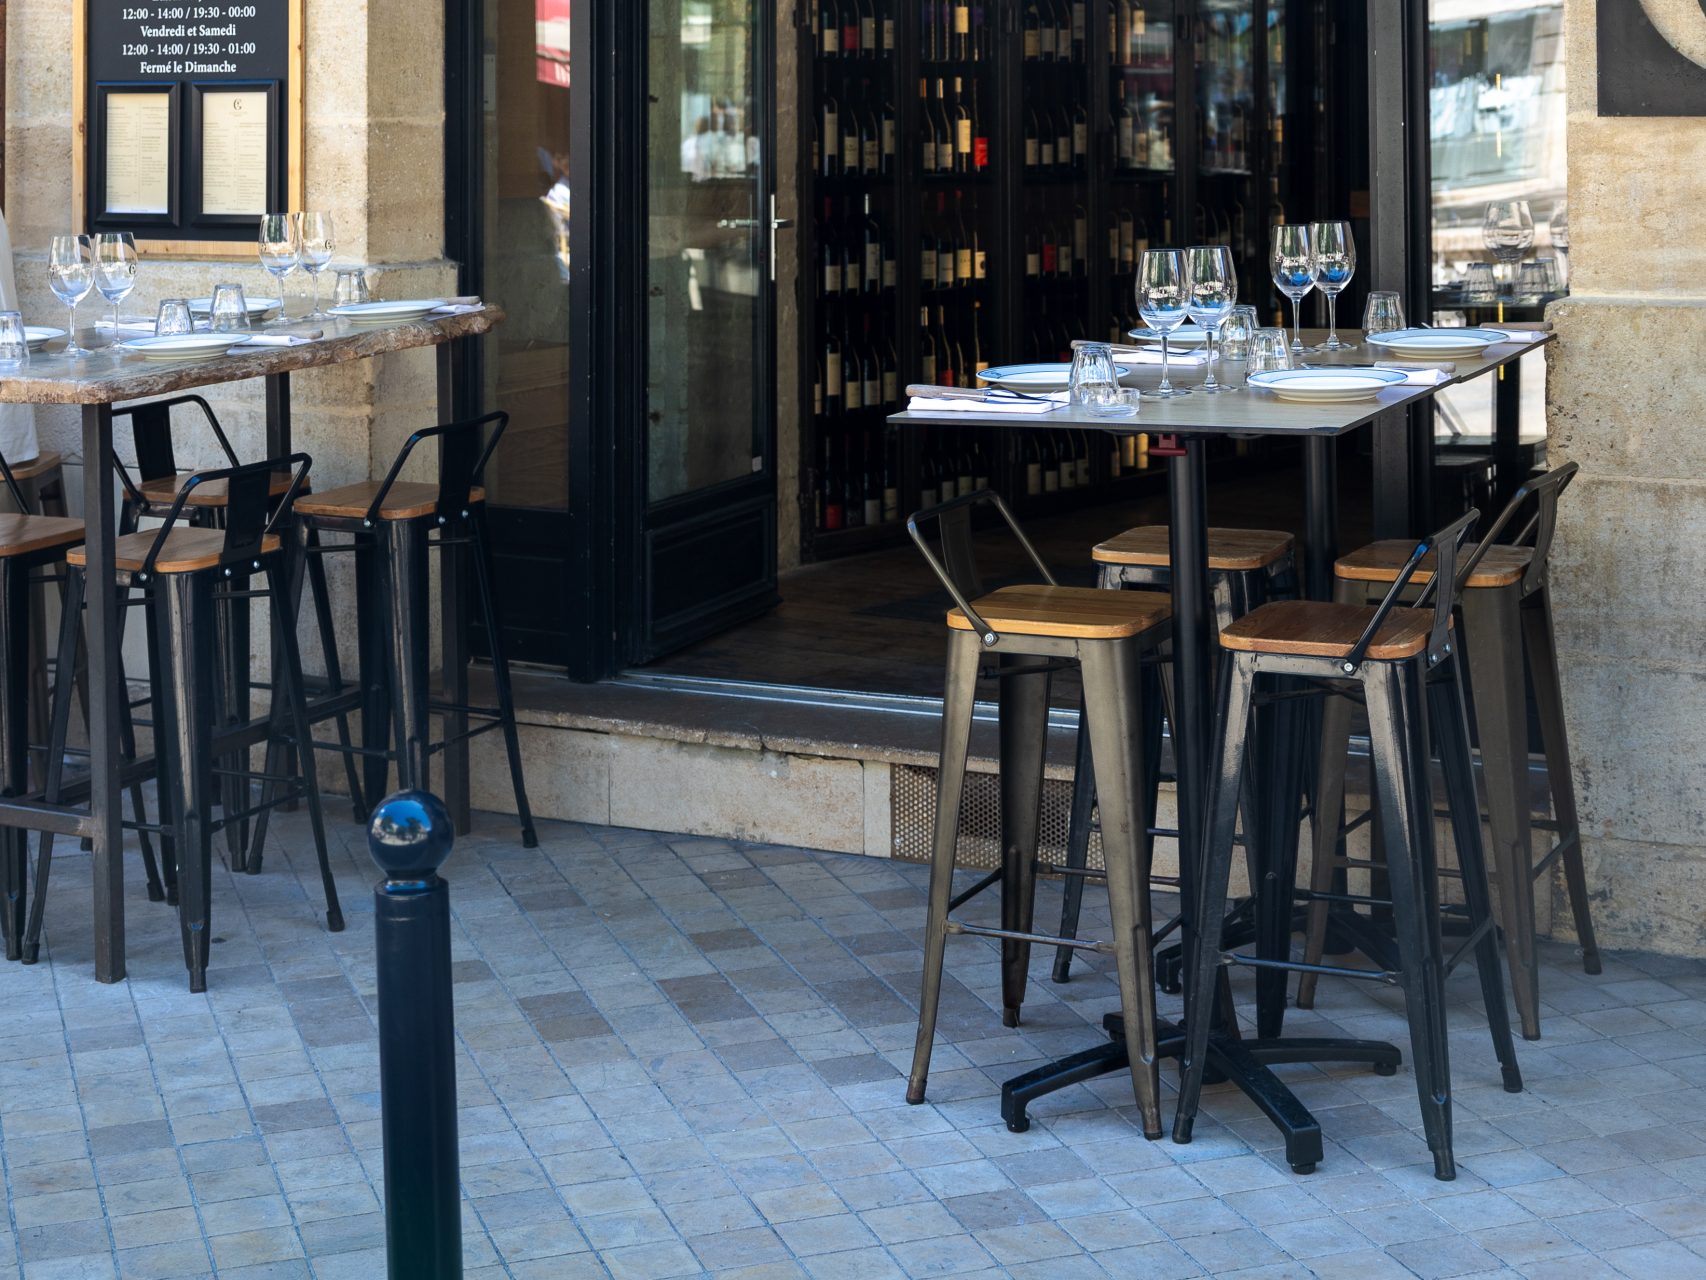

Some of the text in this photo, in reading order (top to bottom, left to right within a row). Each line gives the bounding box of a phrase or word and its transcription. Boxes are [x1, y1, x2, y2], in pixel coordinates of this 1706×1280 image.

[123, 8, 148, 19] 12:00
[158, 8, 183, 19] 14:00
[194, 7, 220, 18] 19:30
[228, 6, 256, 17] 00:00
[140, 24, 236, 37] Vendredi et Samedi
[123, 44, 148, 55] 12:00
[158, 44, 183, 55] 14:00
[194, 43, 219, 54] 19:30
[228, 42, 256, 54] 01:00
[140, 60, 236, 73] Fermé le Dimanche
